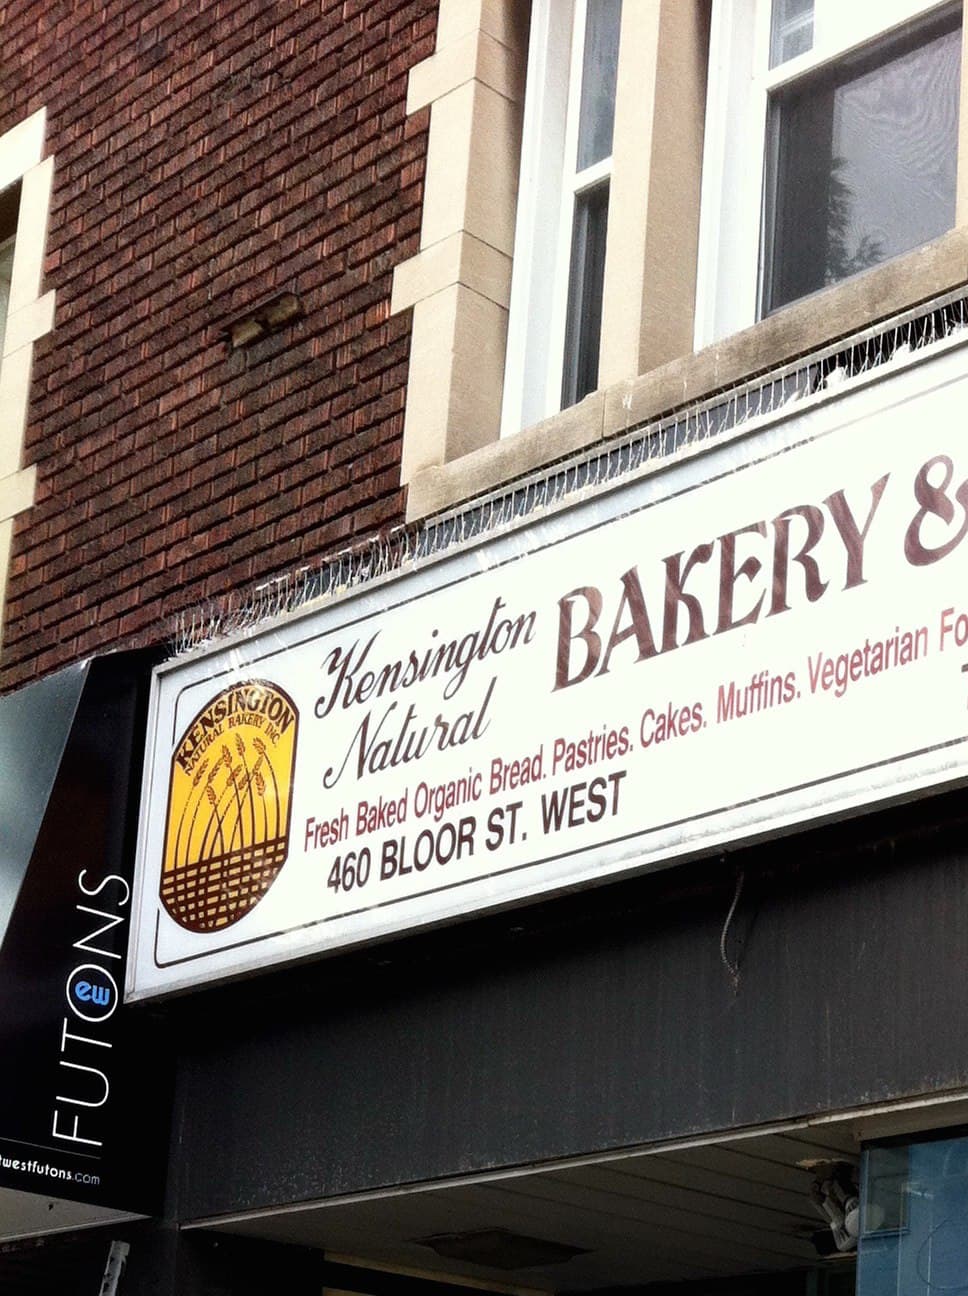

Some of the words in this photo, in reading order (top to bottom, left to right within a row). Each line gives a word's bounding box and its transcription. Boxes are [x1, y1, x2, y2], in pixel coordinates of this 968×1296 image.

[551, 472, 891, 692] BAKERY
[314, 596, 537, 719] Kensington
[176, 688, 294, 773] KENSINGTON
[185, 725, 225, 776] NATURAL
[228, 713, 264, 728] BAKERY
[304, 808, 349, 852] Fresh
[356, 788, 407, 836] Baked
[414, 767, 482, 823] Organic
[489, 744, 546, 794] Bread.
[552, 724, 634, 776] Pastries.
[640, 701, 707, 748] Cakes.
[717, 670, 801, 724] Muffins.
[807, 626, 928, 698] Vegetarian
[322, 676, 498, 789] Natural
[327, 847, 371, 893] 460
[380, 816, 476, 881] BLOOR
[486, 801, 527, 851] ST.
[541, 770, 627, 835] WEST
[52, 869, 129, 1147] FUTONS
